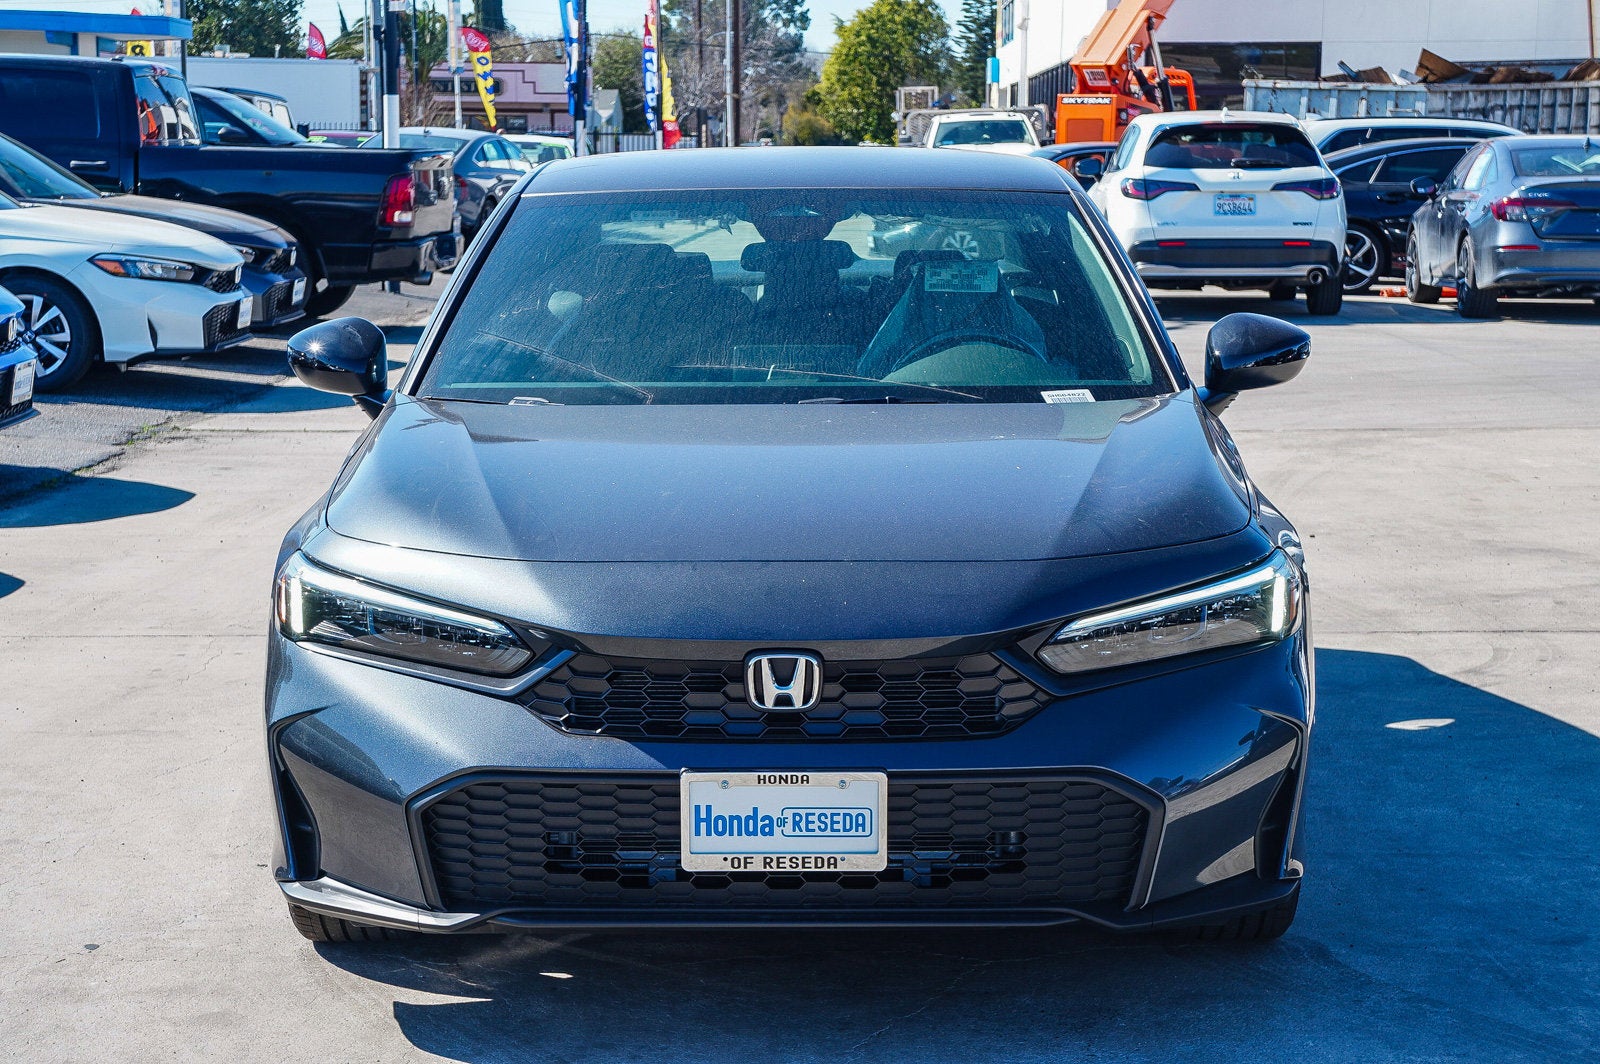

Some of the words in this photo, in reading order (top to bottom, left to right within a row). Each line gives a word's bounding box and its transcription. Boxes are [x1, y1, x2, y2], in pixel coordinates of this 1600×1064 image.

[757, 774, 810, 785] HONDA
[694, 805, 774, 837] Honda
[776, 817, 788, 828] OF
[792, 812, 866, 833] RESEDA
[730, 857, 753, 869] OF
[763, 857, 838, 869] RESEDA
